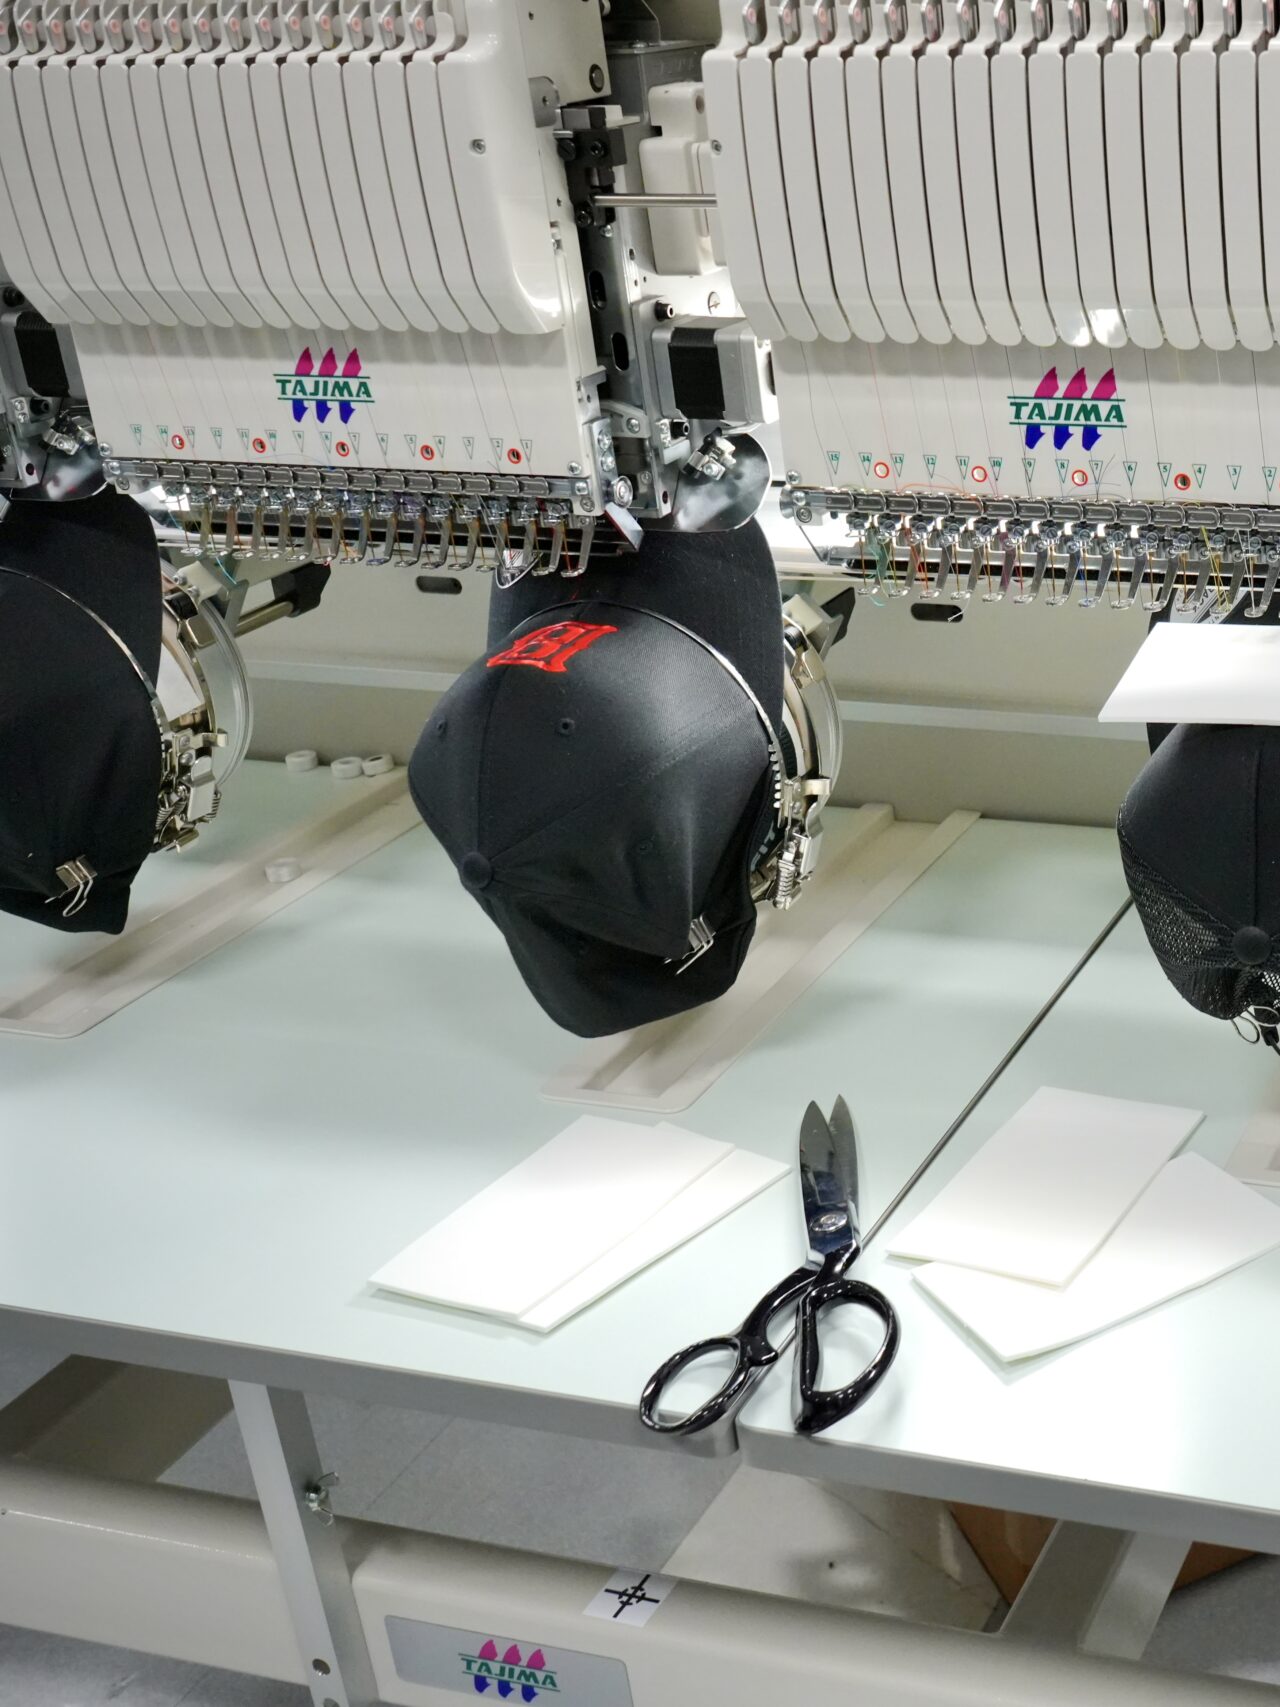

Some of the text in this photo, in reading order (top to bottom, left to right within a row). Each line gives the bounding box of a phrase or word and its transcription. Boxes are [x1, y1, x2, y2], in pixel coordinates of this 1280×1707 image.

[275, 378, 372, 398] TAJIMA
[1010, 401, 1125, 423] TAJIMA
[862, 455, 871, 463] 14
[894, 456, 903, 464] 13
[926, 457, 935, 465] 12
[1232, 468, 1237, 476] 3
[1267, 469, 1272, 477] 2
[460, 1656, 558, 1688] TAJIMA
